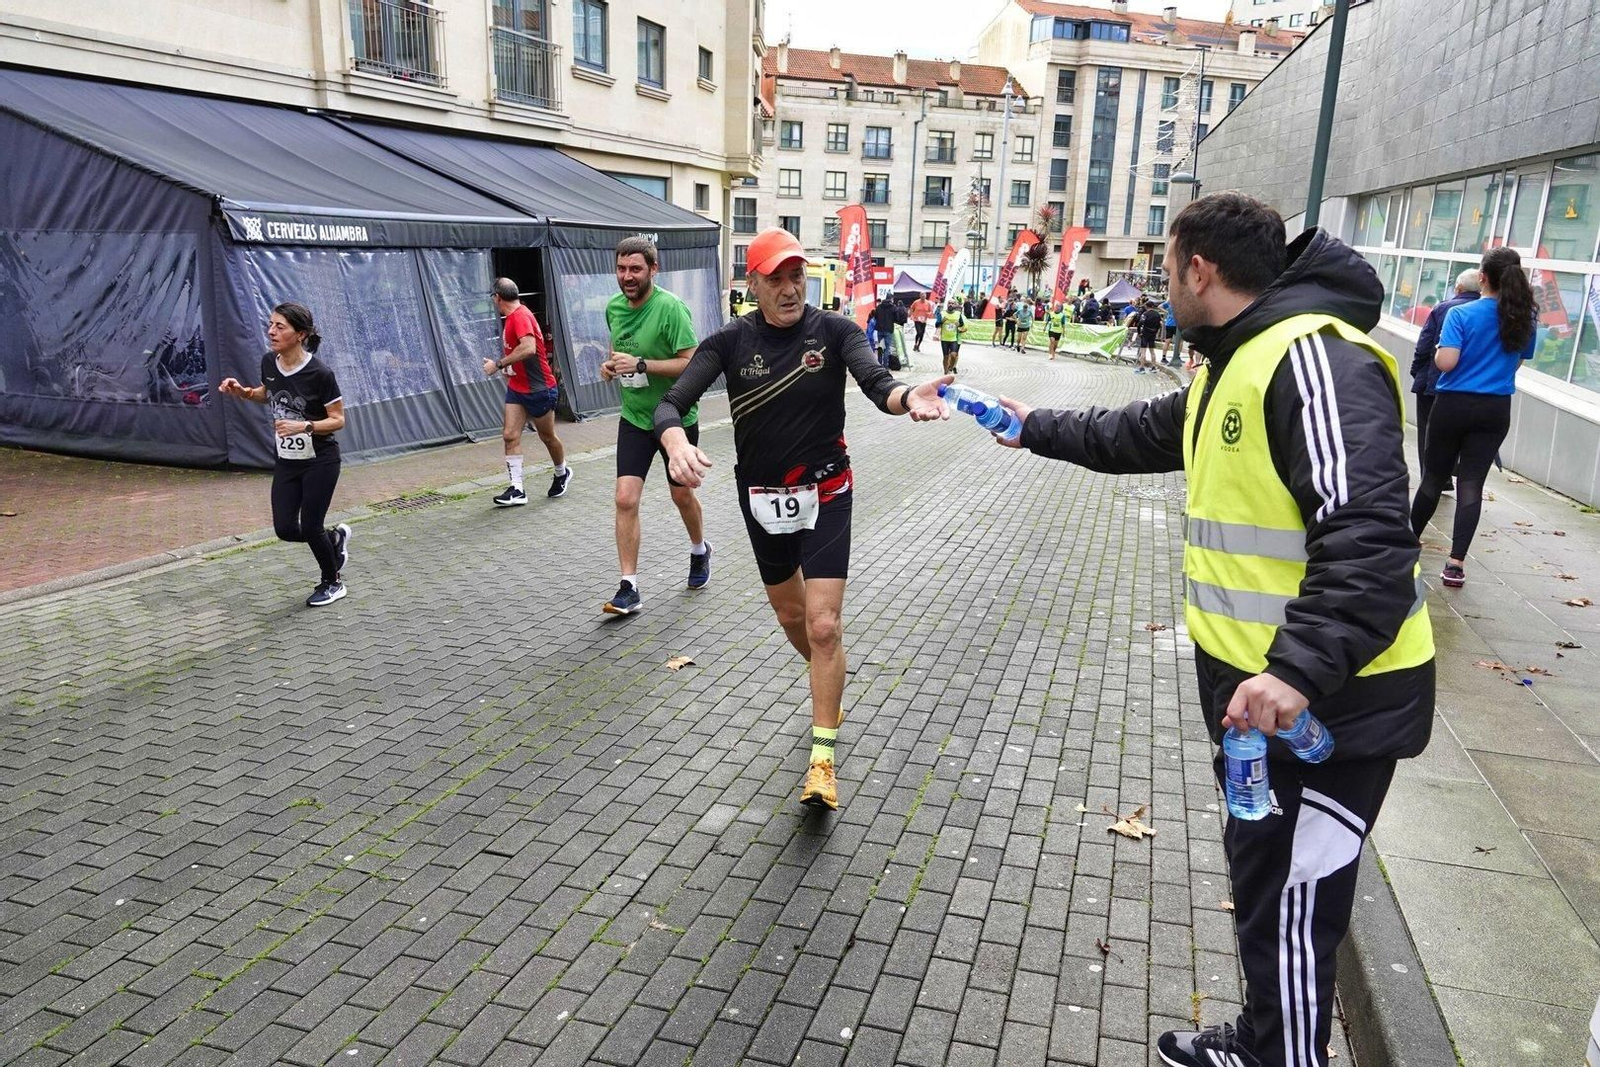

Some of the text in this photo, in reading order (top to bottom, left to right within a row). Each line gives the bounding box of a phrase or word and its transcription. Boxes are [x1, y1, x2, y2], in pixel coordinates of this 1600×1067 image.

[267, 221, 369, 241] CERVEZAS ALHAMBRA
[998, 261, 1014, 287] RUN
[1058, 262, 1068, 292] RUN
[740, 367, 770, 377] El Trigal
[280, 437, 305, 450] 229
[770, 497, 800, 518] 19
